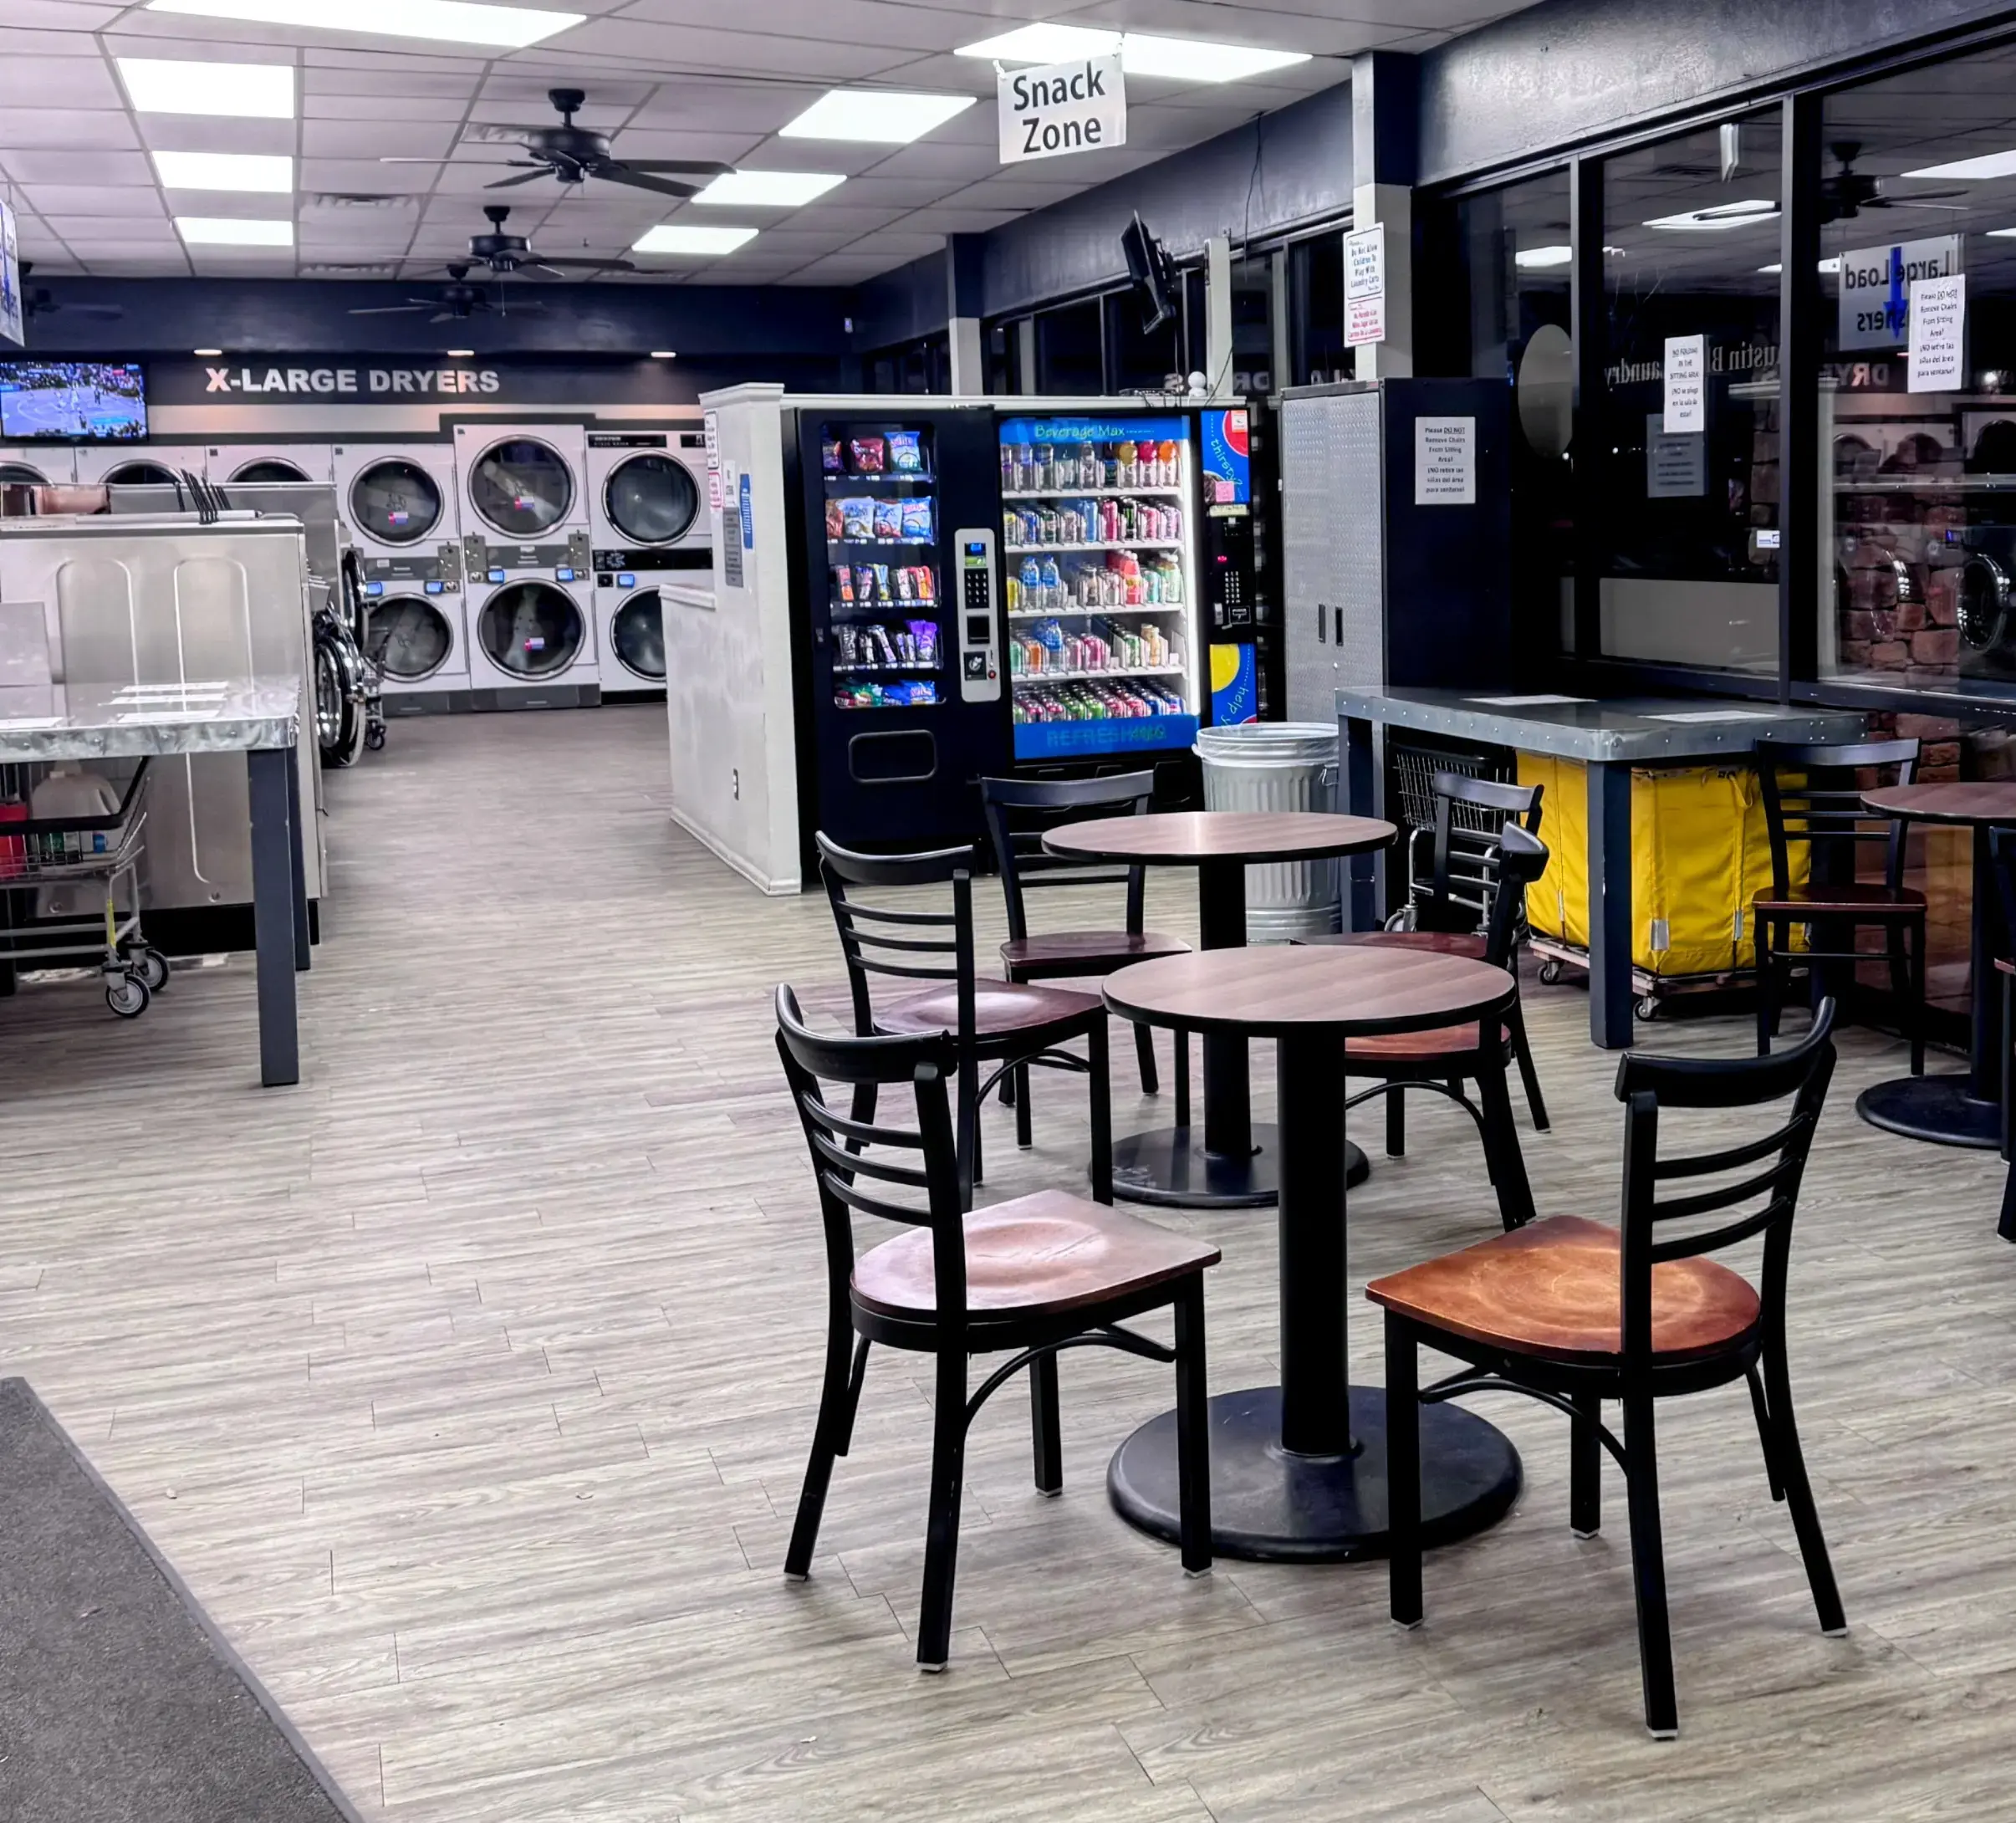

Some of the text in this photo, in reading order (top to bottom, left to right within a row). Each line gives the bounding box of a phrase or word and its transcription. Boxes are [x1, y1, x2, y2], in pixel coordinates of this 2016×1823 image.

[1013, 60, 1106, 111] Snack
[1022, 117, 1102, 154] Zone
[206, 368, 500, 393] X-LARGE DRYERS
[1034, 423, 1125, 439] Beverage Max
[1227, 687, 1249, 714] help
